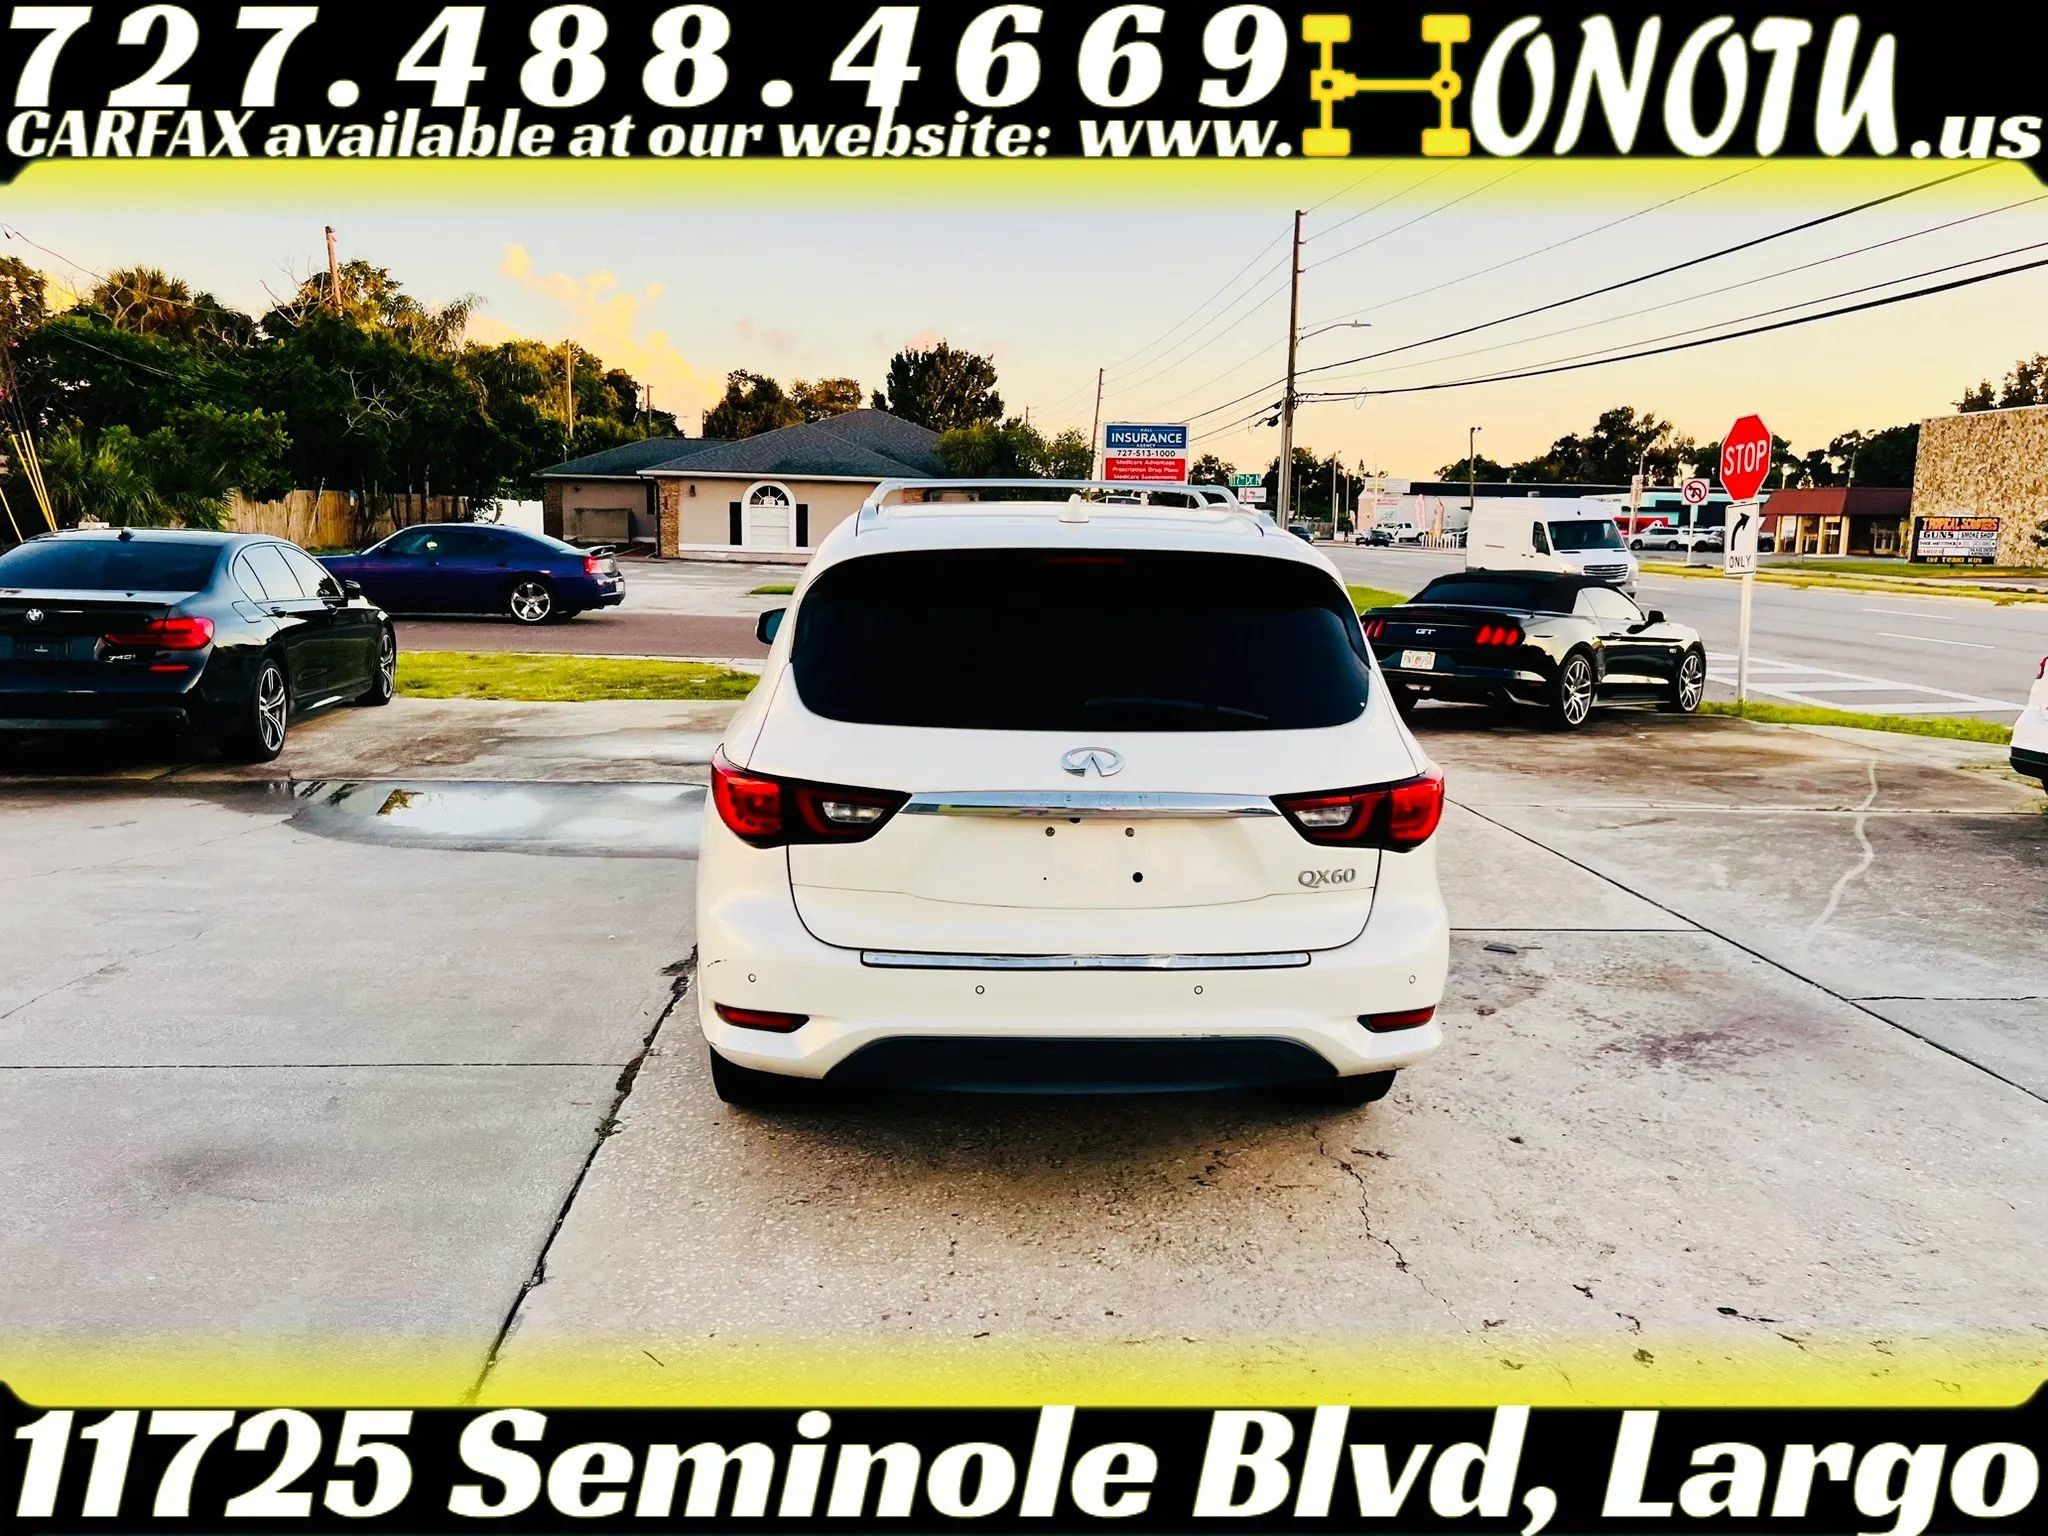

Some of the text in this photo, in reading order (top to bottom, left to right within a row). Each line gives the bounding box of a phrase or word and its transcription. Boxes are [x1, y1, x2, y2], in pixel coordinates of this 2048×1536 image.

[1111, 432, 1183, 443] INSURANCE
[1723, 439, 1768, 476] STOP
[1729, 554, 1752, 568] ONLY
[1298, 868, 1357, 889] QX60
